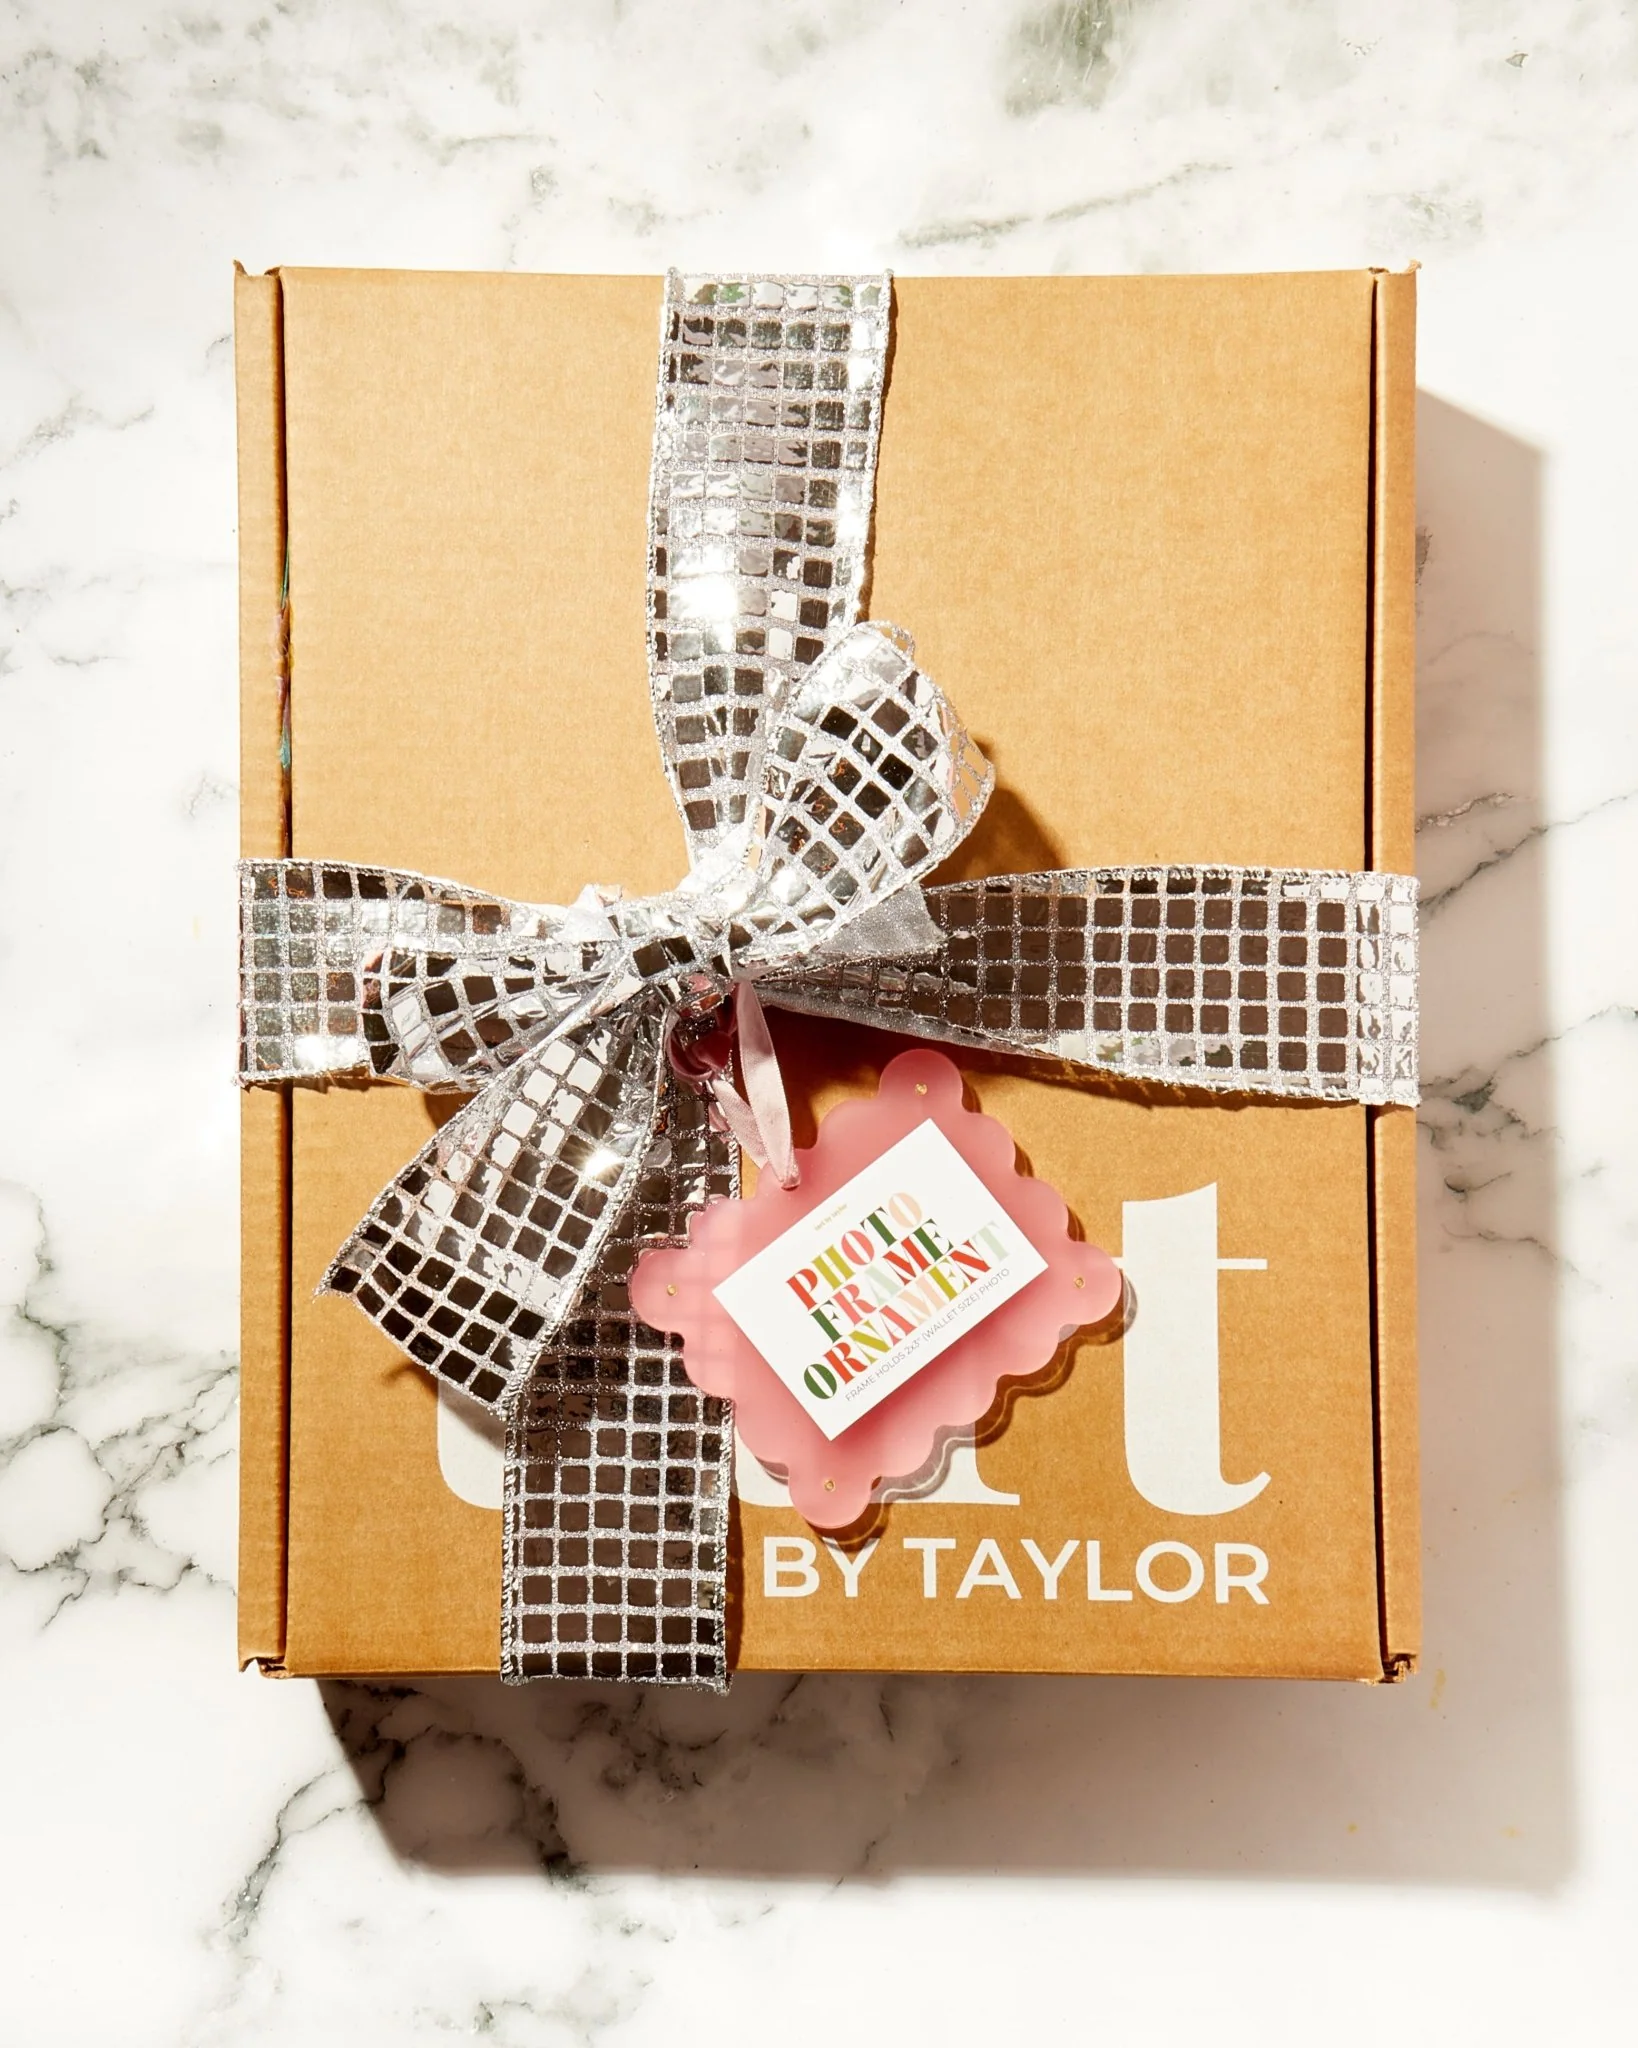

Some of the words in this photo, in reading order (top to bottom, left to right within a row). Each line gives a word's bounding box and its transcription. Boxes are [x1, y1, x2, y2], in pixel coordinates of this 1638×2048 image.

[786, 1192, 922, 1311] PHOTO
[803, 1220, 1010, 1400] ORNAMENT
[810, 1218, 954, 1343] FRAME
[845, 1374, 877, 1402] FRAME
[874, 1354, 906, 1379] HOLDS
[921, 1308, 959, 1342] (WALLET
[958, 1291, 981, 1312] SIZE)
[980, 1268, 1010, 1297] PHOTO
[763, 1536, 881, 1598] BY
[903, 1538, 1270, 1605] TAYLOR
